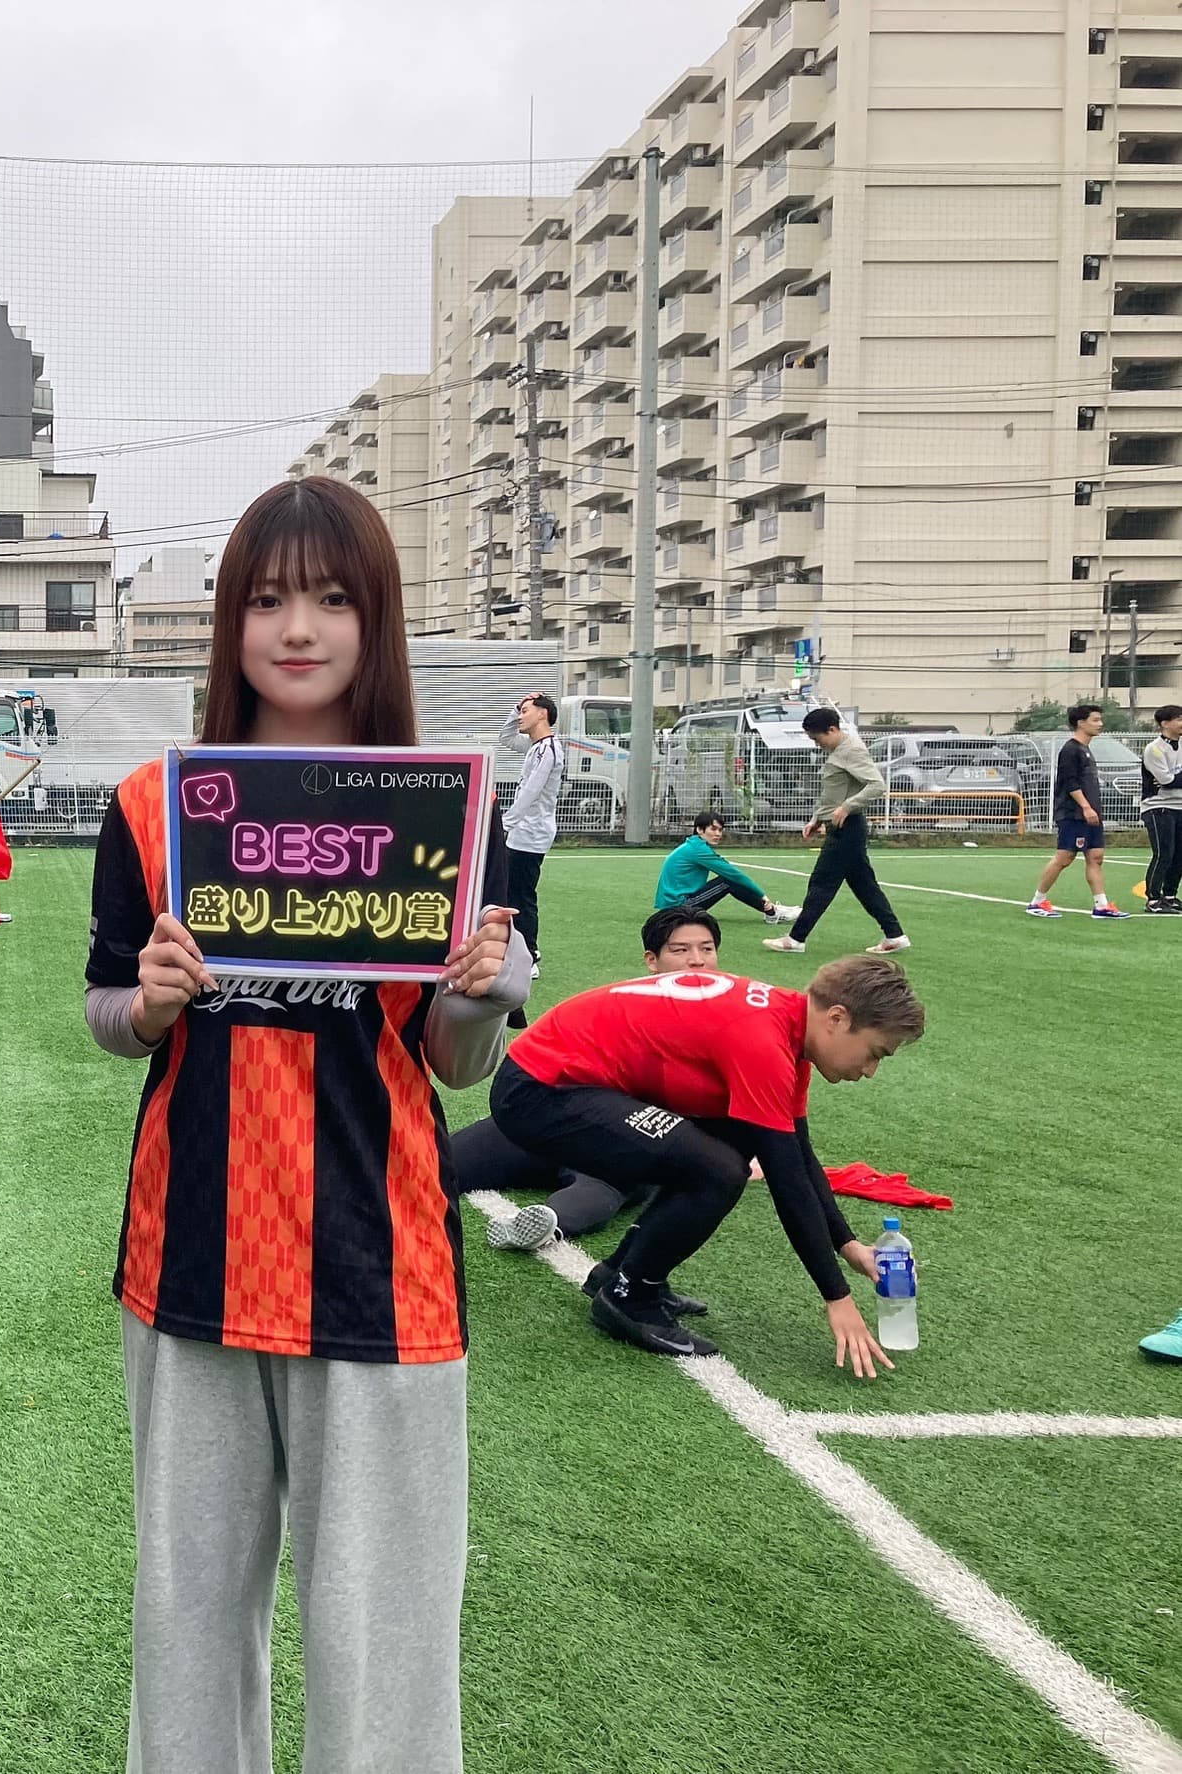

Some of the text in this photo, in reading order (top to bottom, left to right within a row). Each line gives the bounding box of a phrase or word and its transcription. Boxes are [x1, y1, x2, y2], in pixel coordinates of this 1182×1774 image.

[232, 823, 393, 876] BEST
[188, 885, 451, 940] 盛り上がり賞
